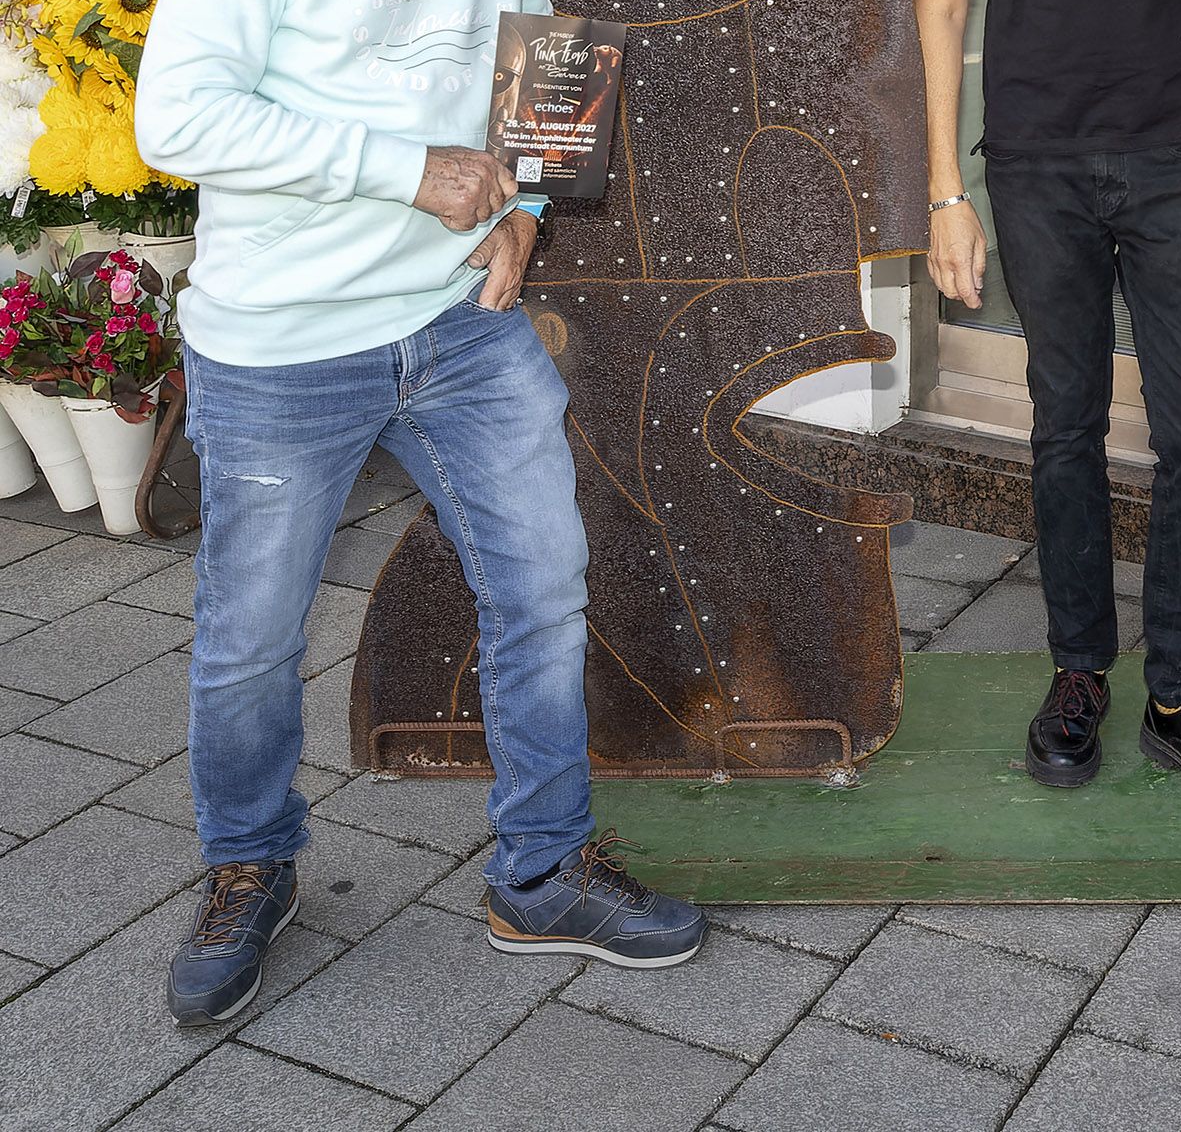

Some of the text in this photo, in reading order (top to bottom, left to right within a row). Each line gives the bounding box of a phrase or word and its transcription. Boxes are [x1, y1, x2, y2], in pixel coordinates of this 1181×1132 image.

[529, 37, 563, 65] PINK
[560, 38, 594, 65] FLOYD
[534, 101, 574, 114] echoes
[540, 122, 576, 132] AUGUST
[503, 131, 519, 139] Live
[520, 132, 531, 141] im
[582, 136, 597, 144] der
[504, 140, 550, 150] Römerstadt
